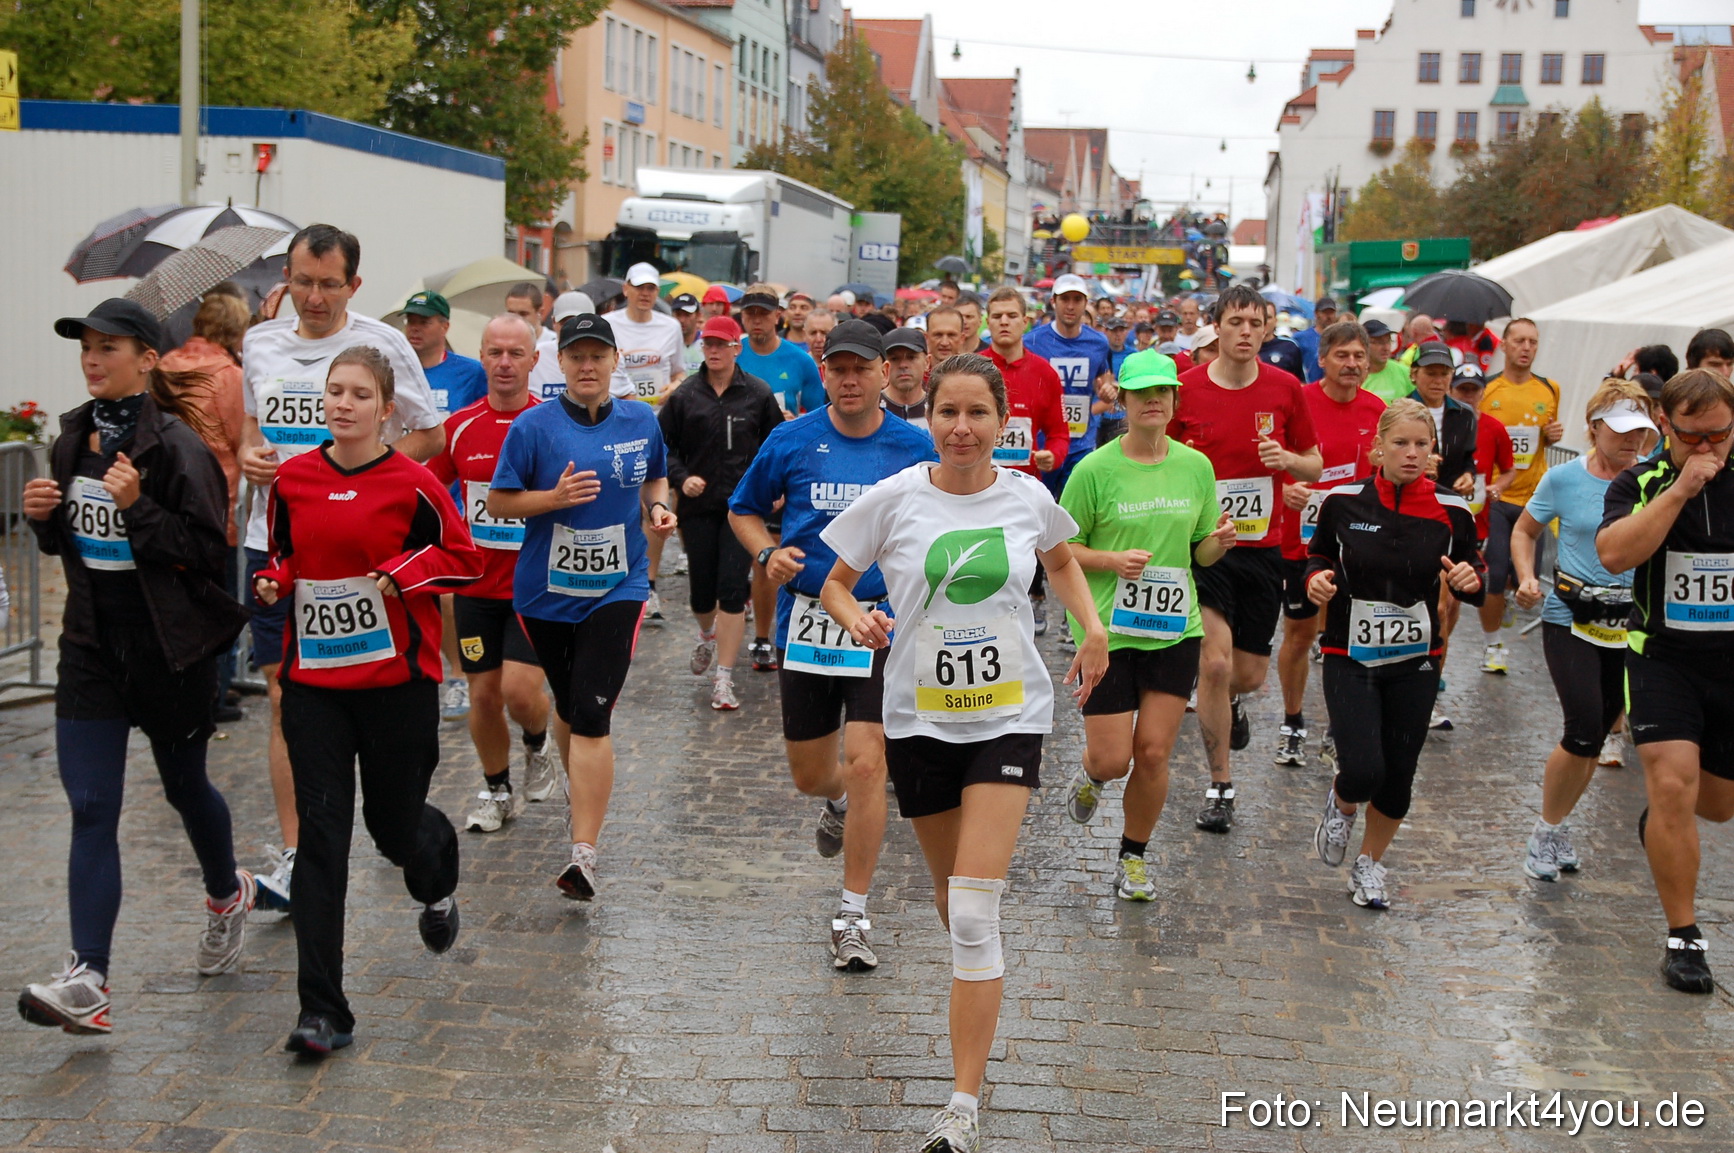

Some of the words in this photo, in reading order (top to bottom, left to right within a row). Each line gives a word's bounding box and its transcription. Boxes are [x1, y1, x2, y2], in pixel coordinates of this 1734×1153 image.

[648, 210, 710, 224] BOCK
[1108, 250, 1146, 259] START
[637, 381, 655, 397] 55
[266, 396, 327, 425] 2555
[276, 430, 317, 444] Stephan
[1221, 494, 1263, 519] 224
[68, 499, 129, 538] 2699
[490, 529, 515, 540] Peter
[1235, 522, 1256, 532] ulian
[1349, 521, 1382, 533] saller
[556, 544, 620, 573] 2554
[313, 584, 348, 595] BOCK
[567, 576, 608, 588] Simone
[1674, 573, 1734, 603] 315
[1122, 582, 1184, 614] 3192
[303, 597, 378, 637] 2698
[1688, 607, 1730, 620] Roland
[1132, 615, 1169, 629] Andrea
[797, 614, 863, 648] 217
[943, 625, 987, 640] BOCK
[1357, 619, 1423, 645] 3125
[317, 640, 368, 656] Ramone
[812, 650, 845, 666] Ralph
[936, 645, 1002, 687] 613
[945, 693, 993, 709] Sabine
